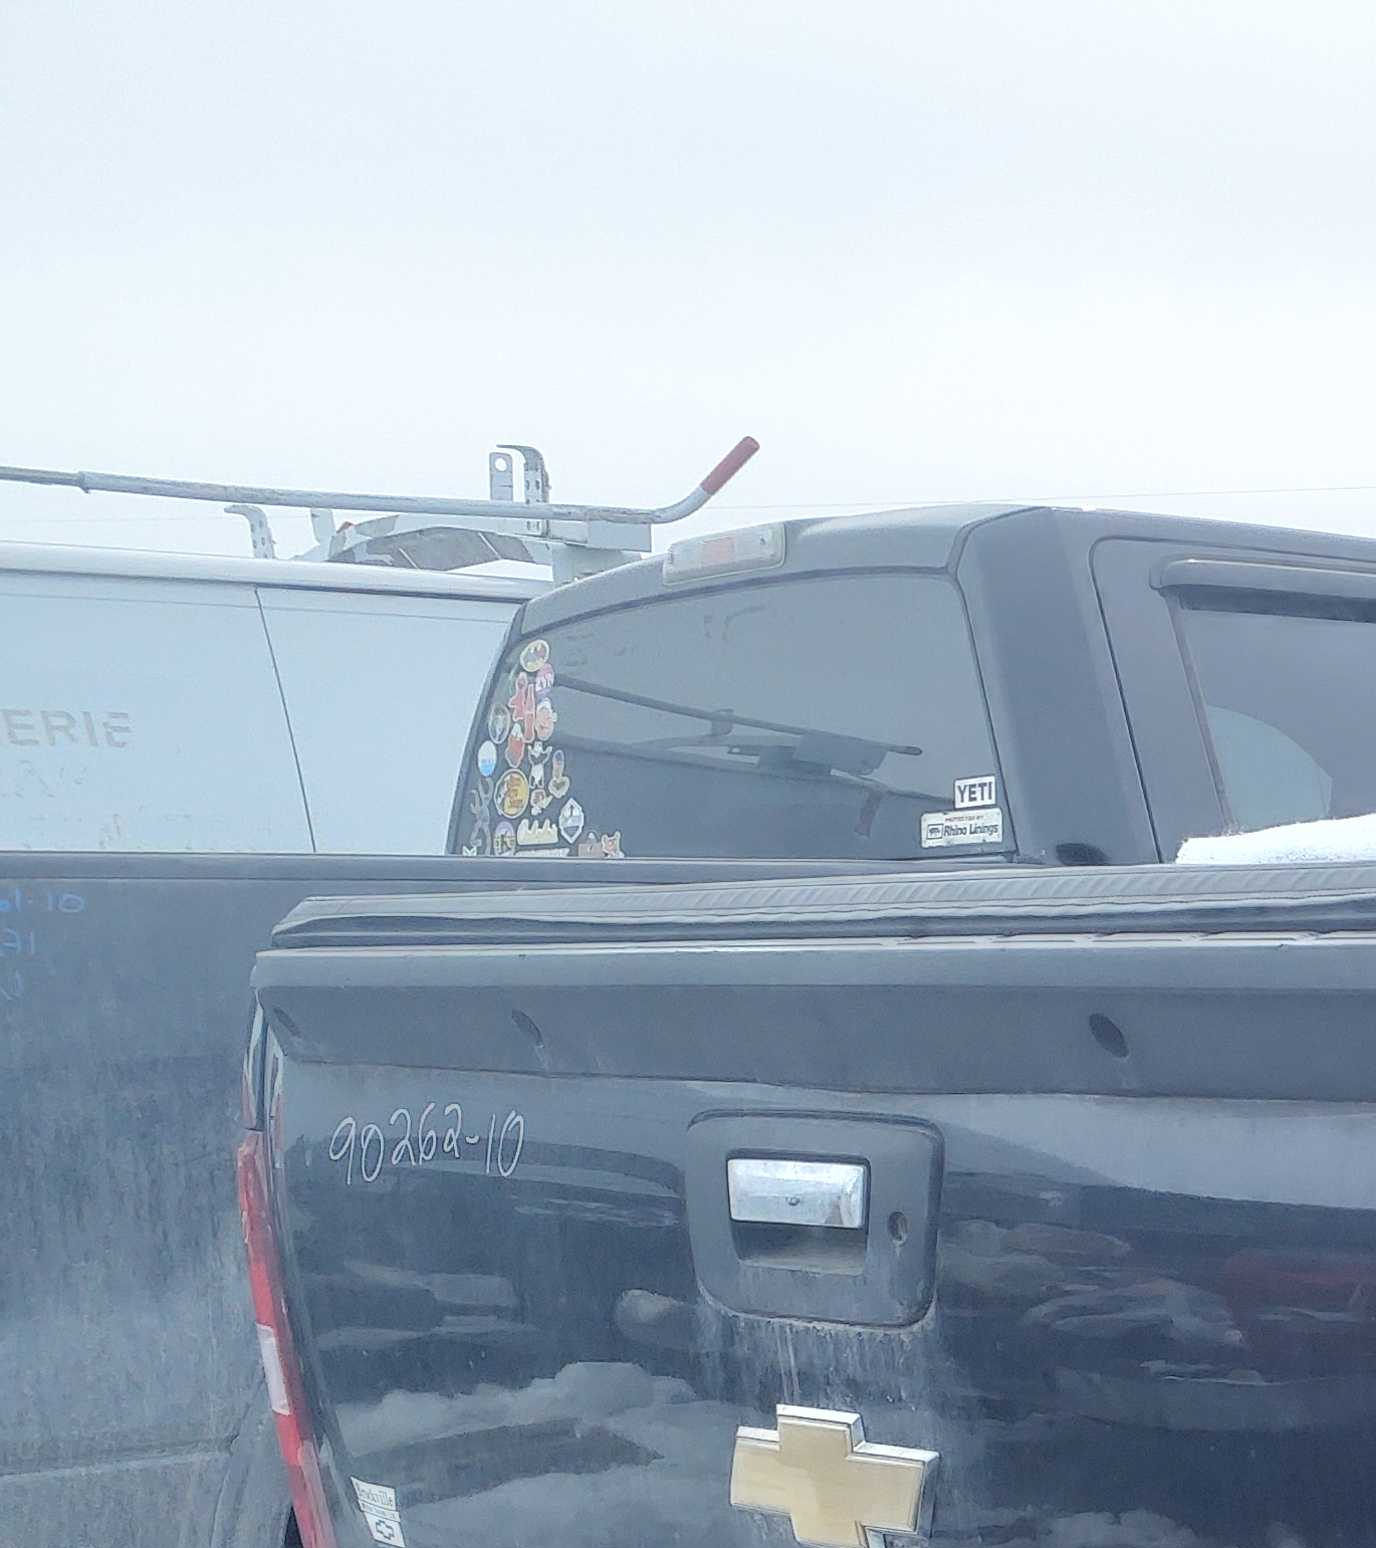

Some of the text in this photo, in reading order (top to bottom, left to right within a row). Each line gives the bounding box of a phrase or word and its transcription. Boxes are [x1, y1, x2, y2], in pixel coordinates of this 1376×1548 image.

[956, 781, 993, 804] YETI
[944, 823, 999, 836] Rhino Linings
[328, 1102, 525, 1185] 90262-10
